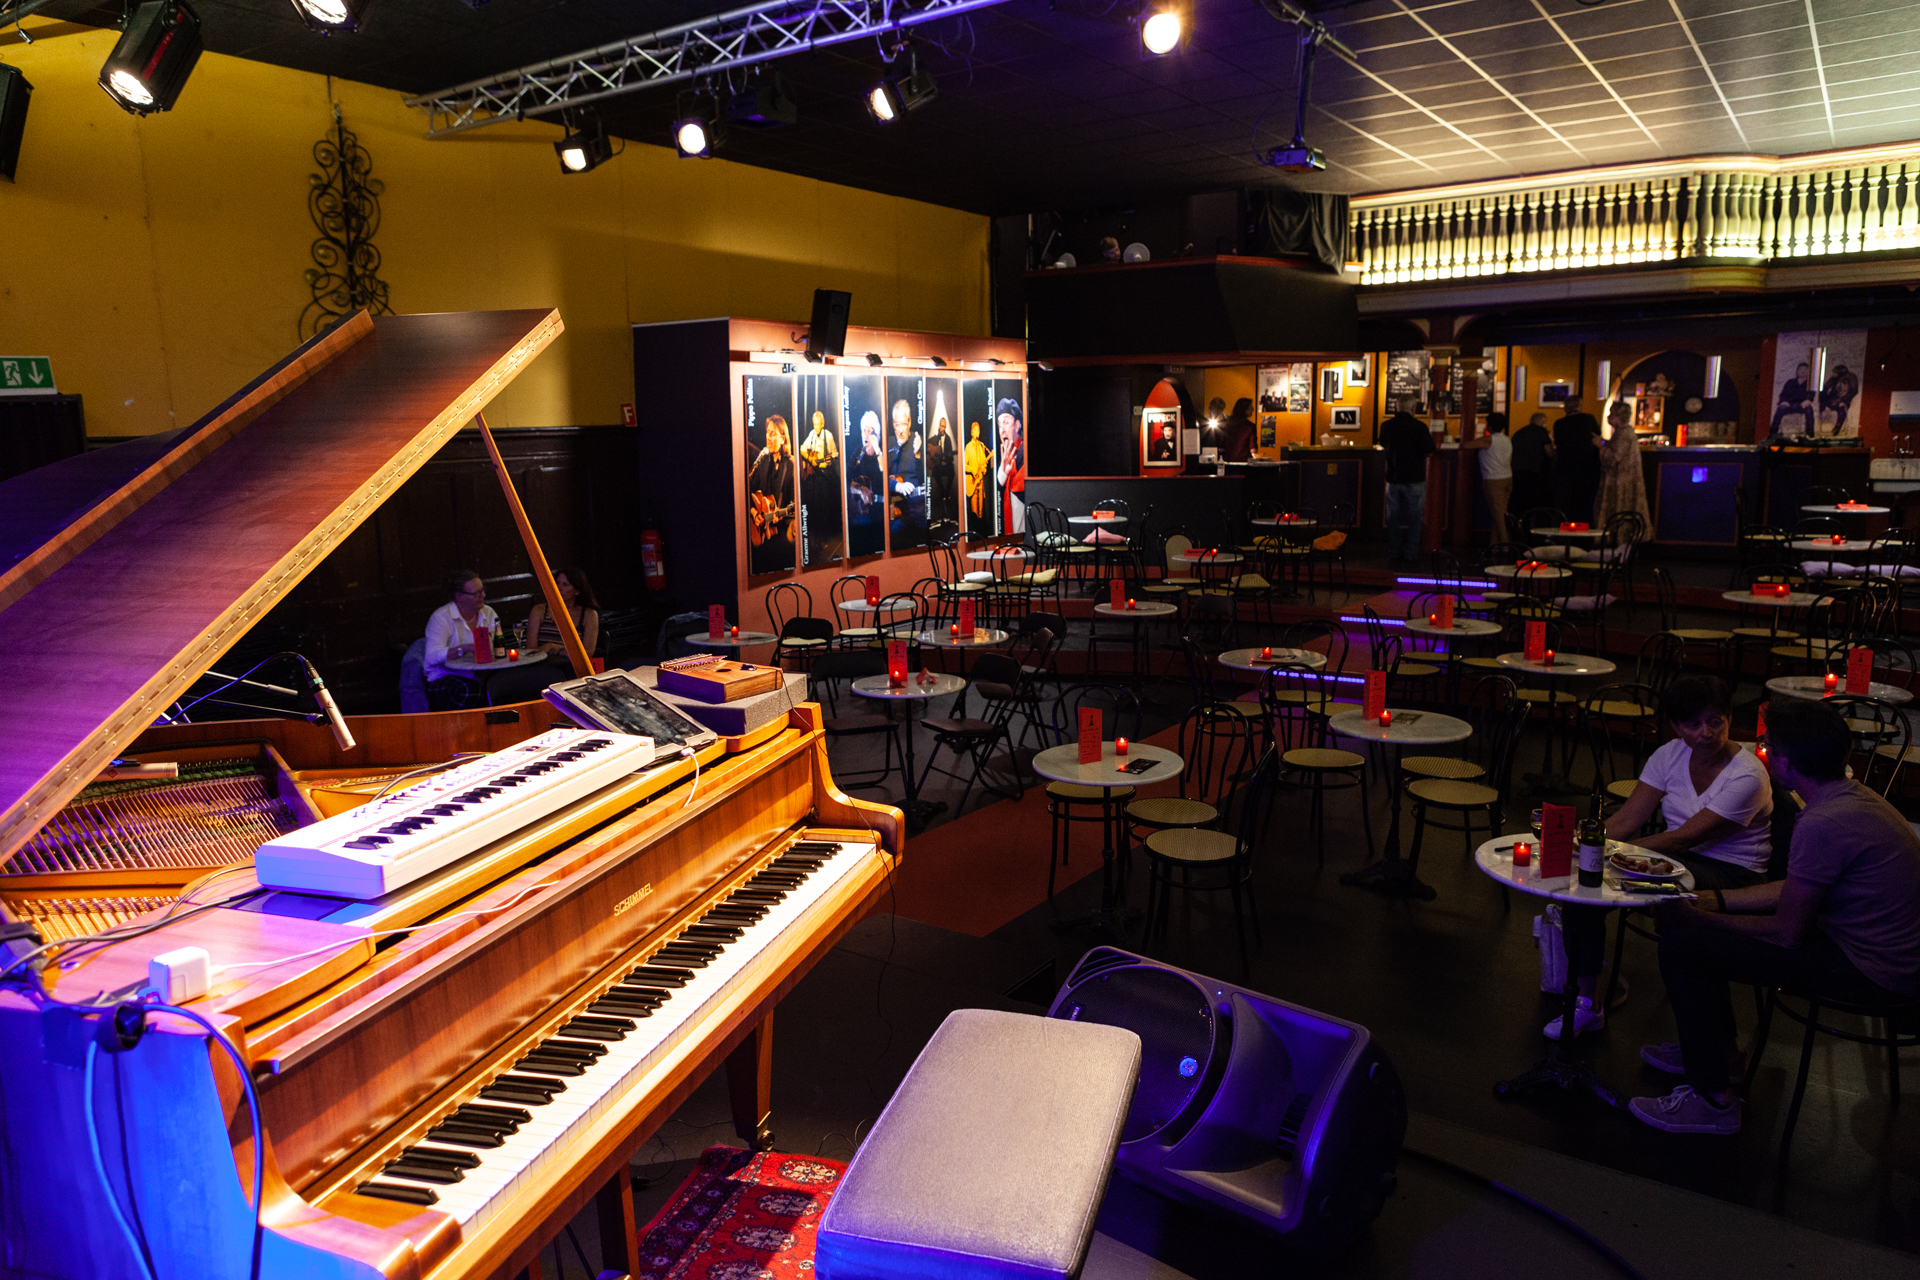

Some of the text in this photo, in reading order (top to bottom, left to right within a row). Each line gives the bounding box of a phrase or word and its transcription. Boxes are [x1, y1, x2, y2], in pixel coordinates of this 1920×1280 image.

[623, 406, 633, 423] F
[747, 405, 756, 427] Pippo
[801, 504, 809, 537] Allwright
[613, 882, 654, 917] SCHIMMEL
